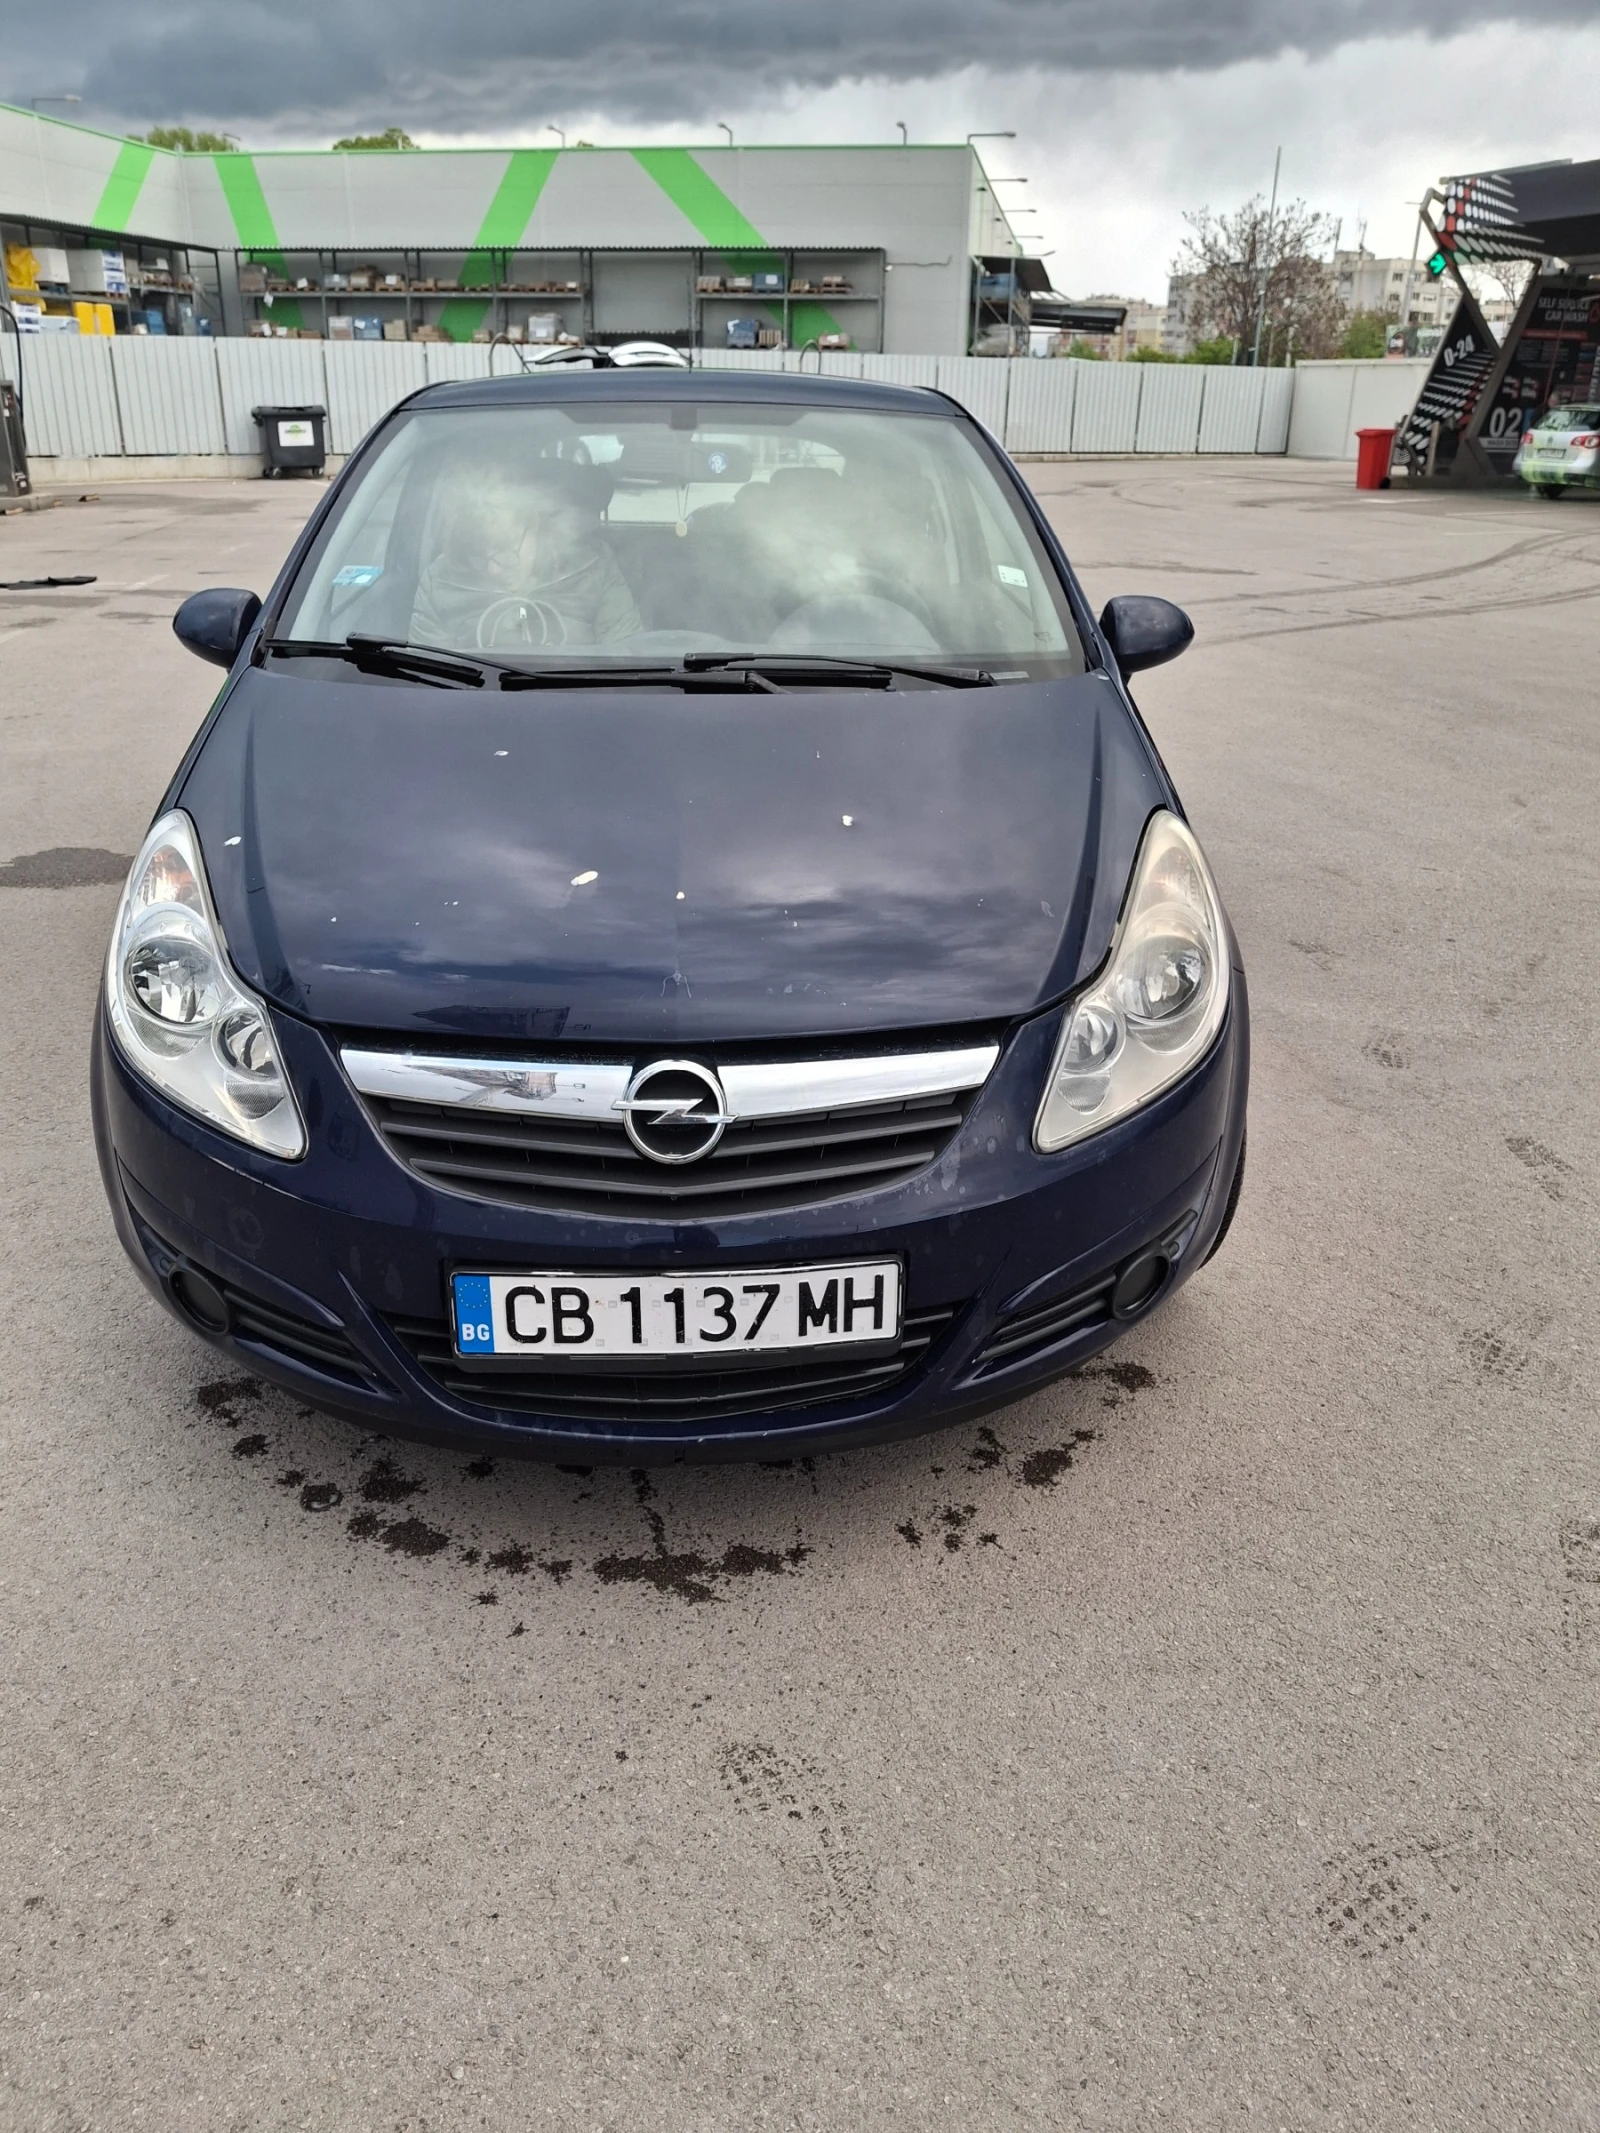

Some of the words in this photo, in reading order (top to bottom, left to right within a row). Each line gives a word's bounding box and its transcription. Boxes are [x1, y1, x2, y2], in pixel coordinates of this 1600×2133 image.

[1538, 297, 1557, 308] SELF
[1545, 310, 1562, 321] CAR
[1443, 334, 1475, 367] 0-24
[1489, 407, 1523, 438] 02
[504, 1286, 594, 1344] CB
[620, 1284, 780, 1344] 1137
[798, 1274, 885, 1337] MH
[462, 1323, 490, 1341] BG
